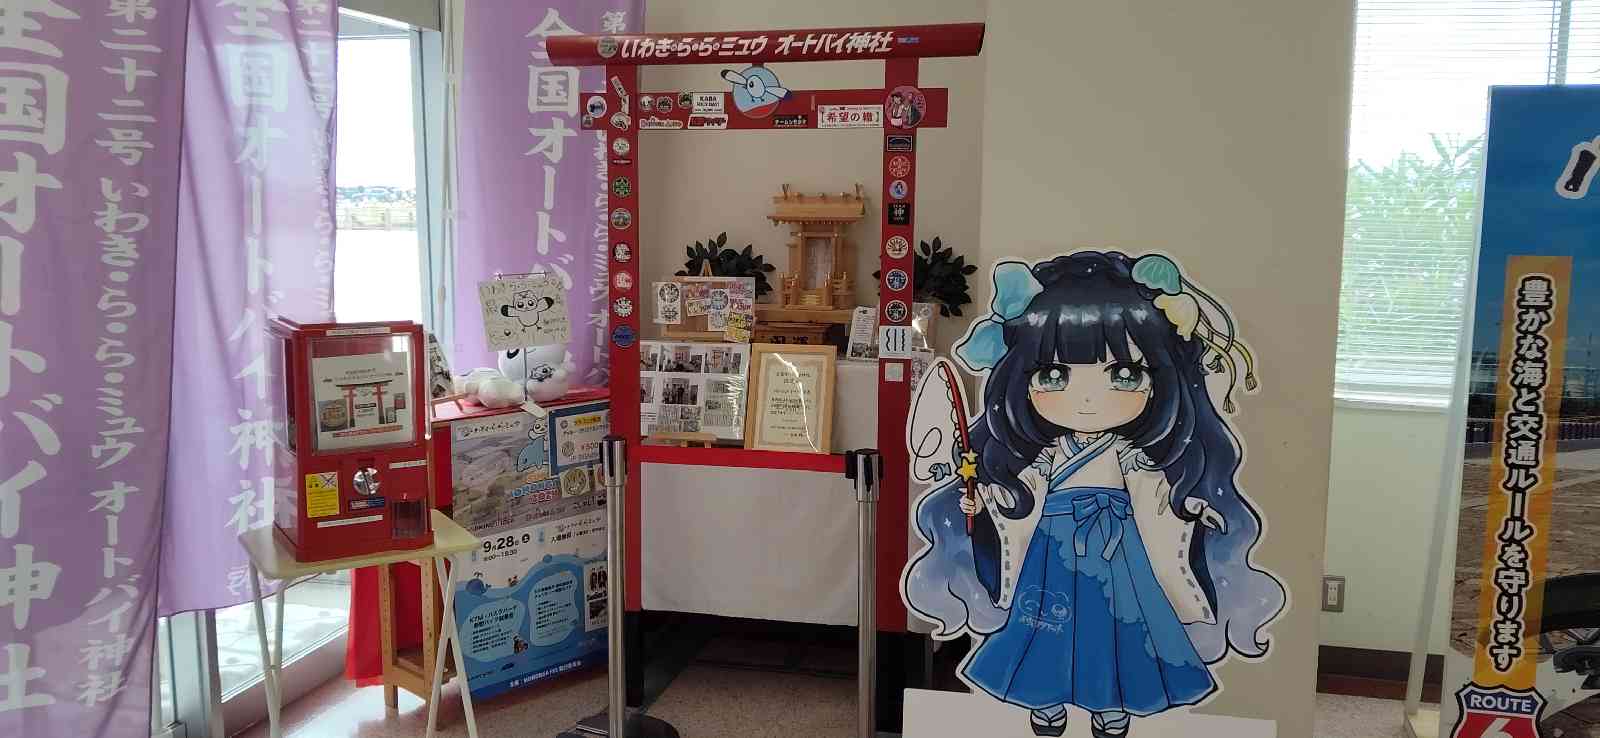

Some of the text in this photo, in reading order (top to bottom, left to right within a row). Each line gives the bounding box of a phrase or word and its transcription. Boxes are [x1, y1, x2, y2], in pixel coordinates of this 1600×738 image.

[775, 31, 894, 55] オートバイ神社
[1490, 276, 1553, 671] 豊かな海と交通ルールを守ります
[1470, 694, 1532, 712] ROUTE
